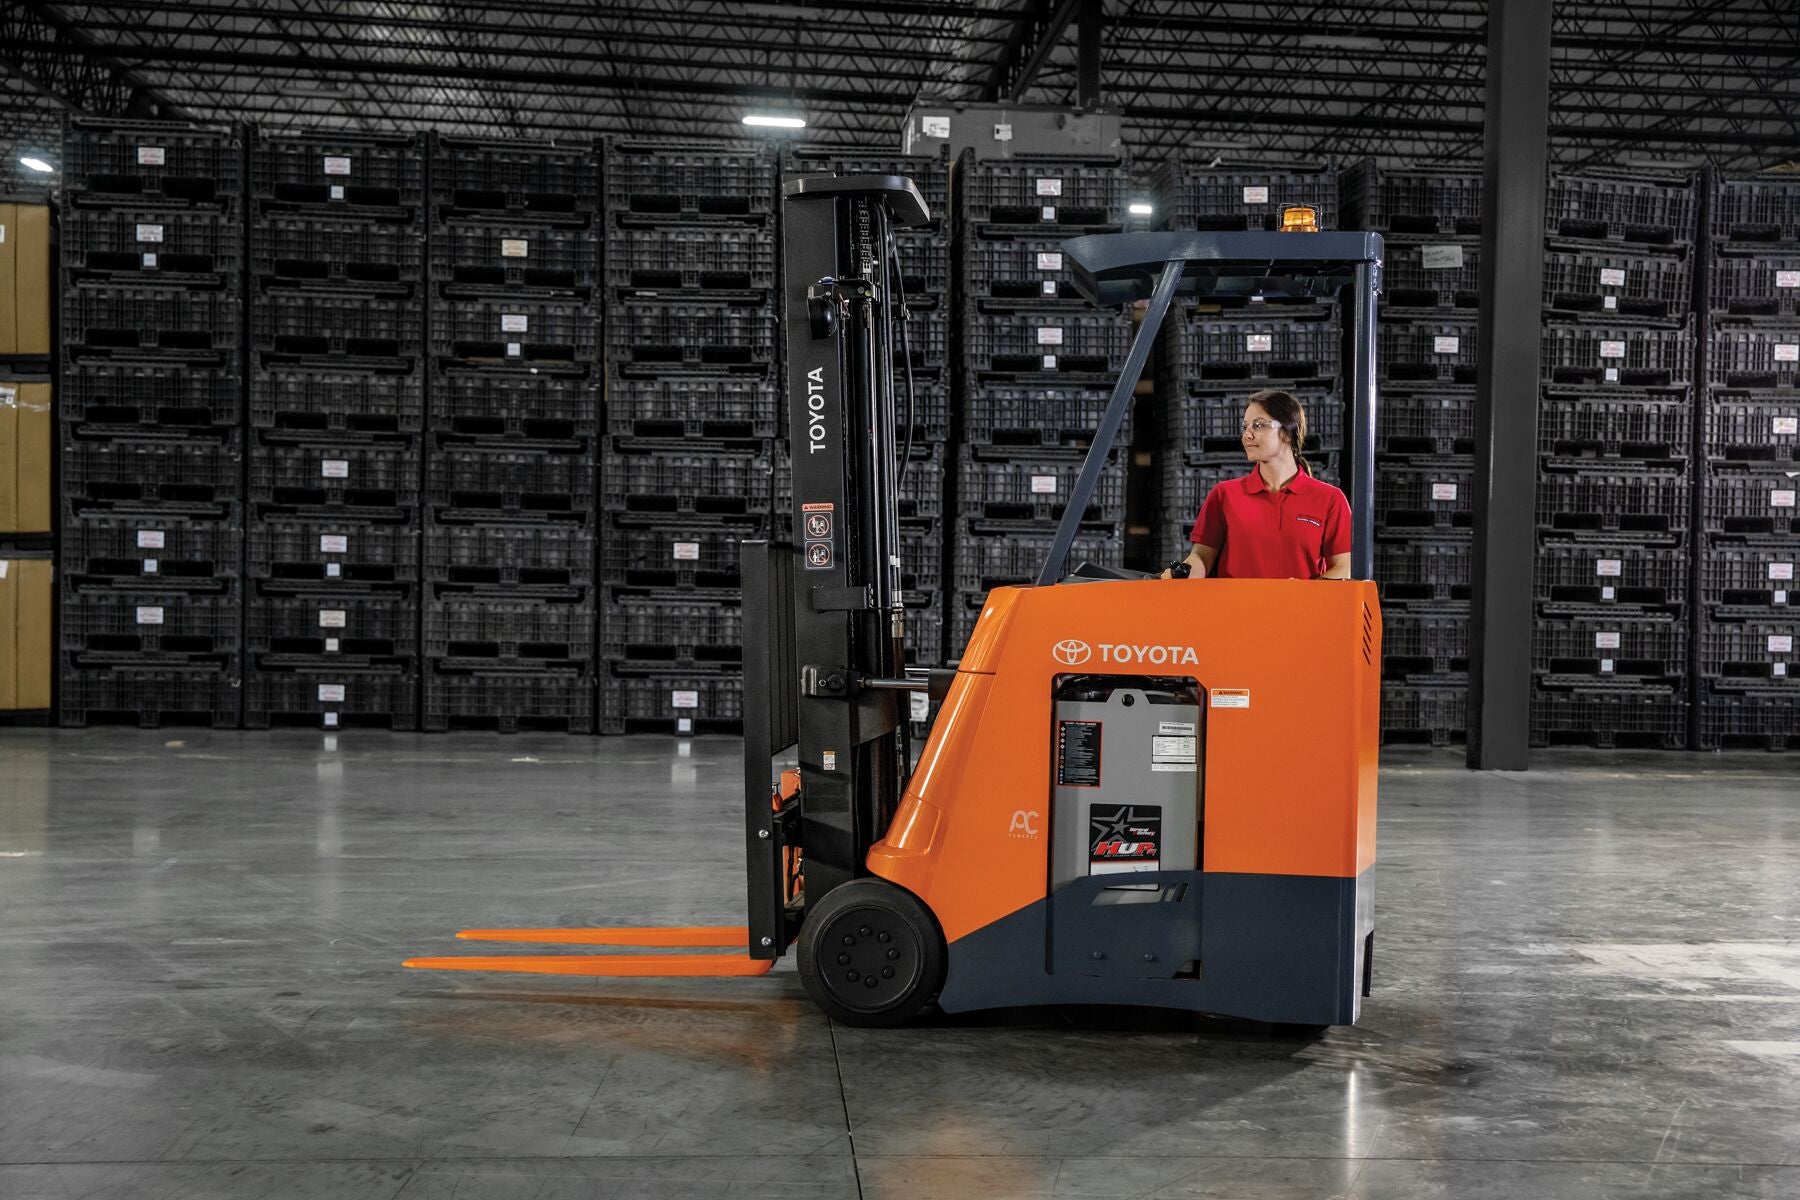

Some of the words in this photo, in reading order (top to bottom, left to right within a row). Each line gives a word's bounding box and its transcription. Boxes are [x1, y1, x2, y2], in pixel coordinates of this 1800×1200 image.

[808, 366, 826, 454] TOYOTA
[1098, 643, 1200, 665] TOYOTA
[1009, 809, 1040, 834] AC
